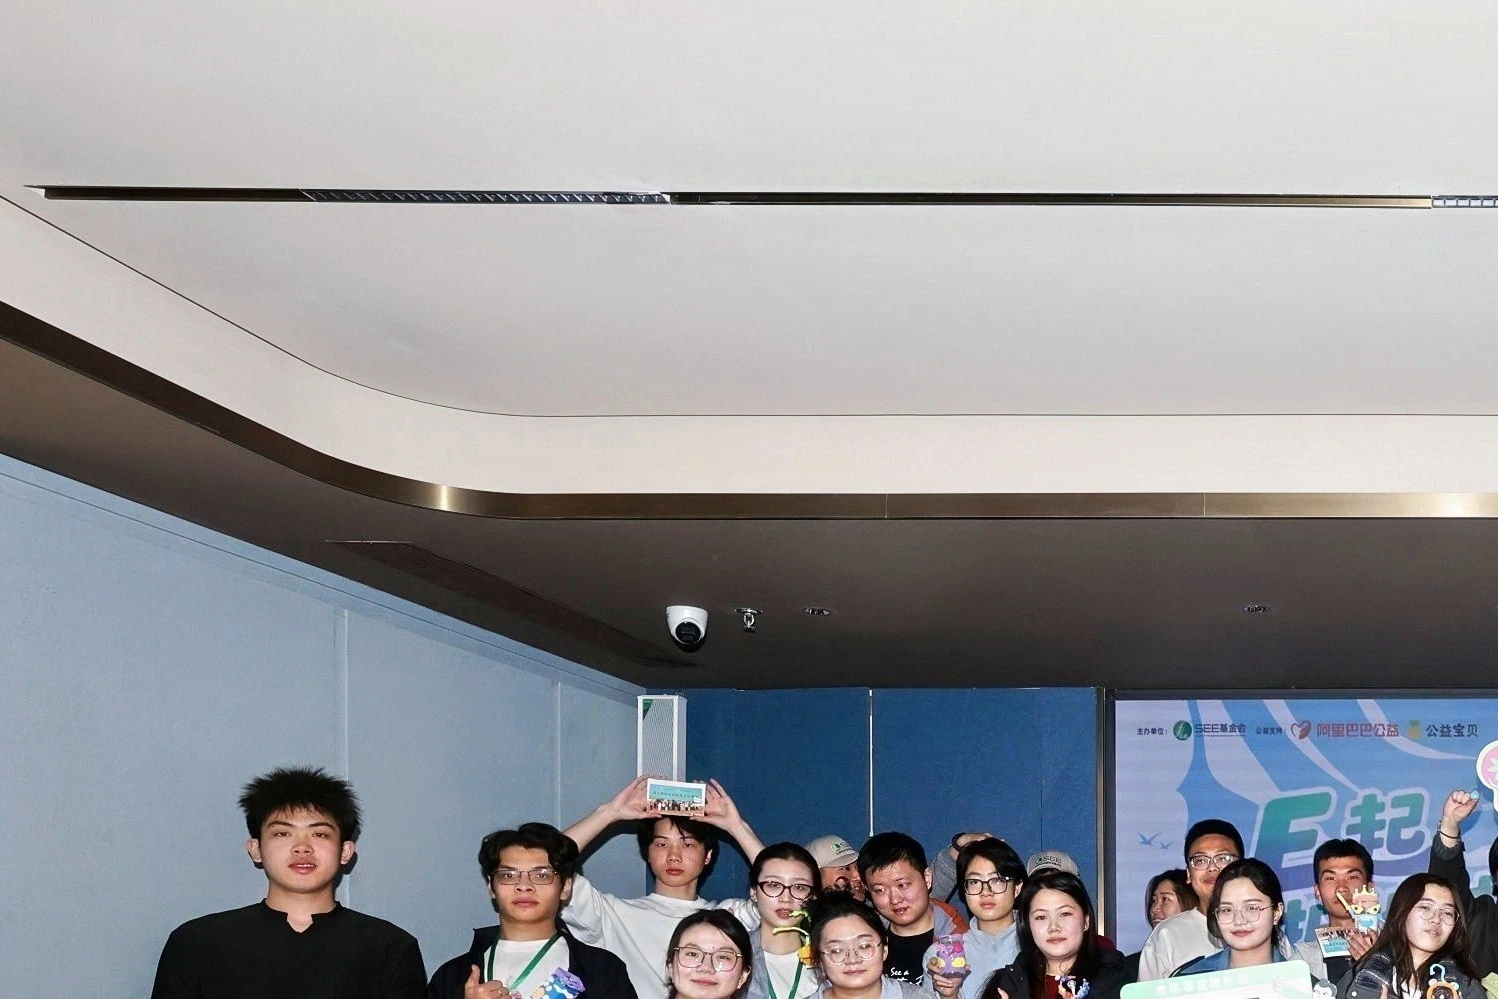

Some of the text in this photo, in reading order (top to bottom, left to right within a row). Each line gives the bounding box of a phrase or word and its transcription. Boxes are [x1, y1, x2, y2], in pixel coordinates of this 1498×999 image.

[1317, 723, 1399, 737] 阿里巴巴公益
[1426, 723, 1478, 737] 公益宝贝
[891, 967, 902, 976] See
